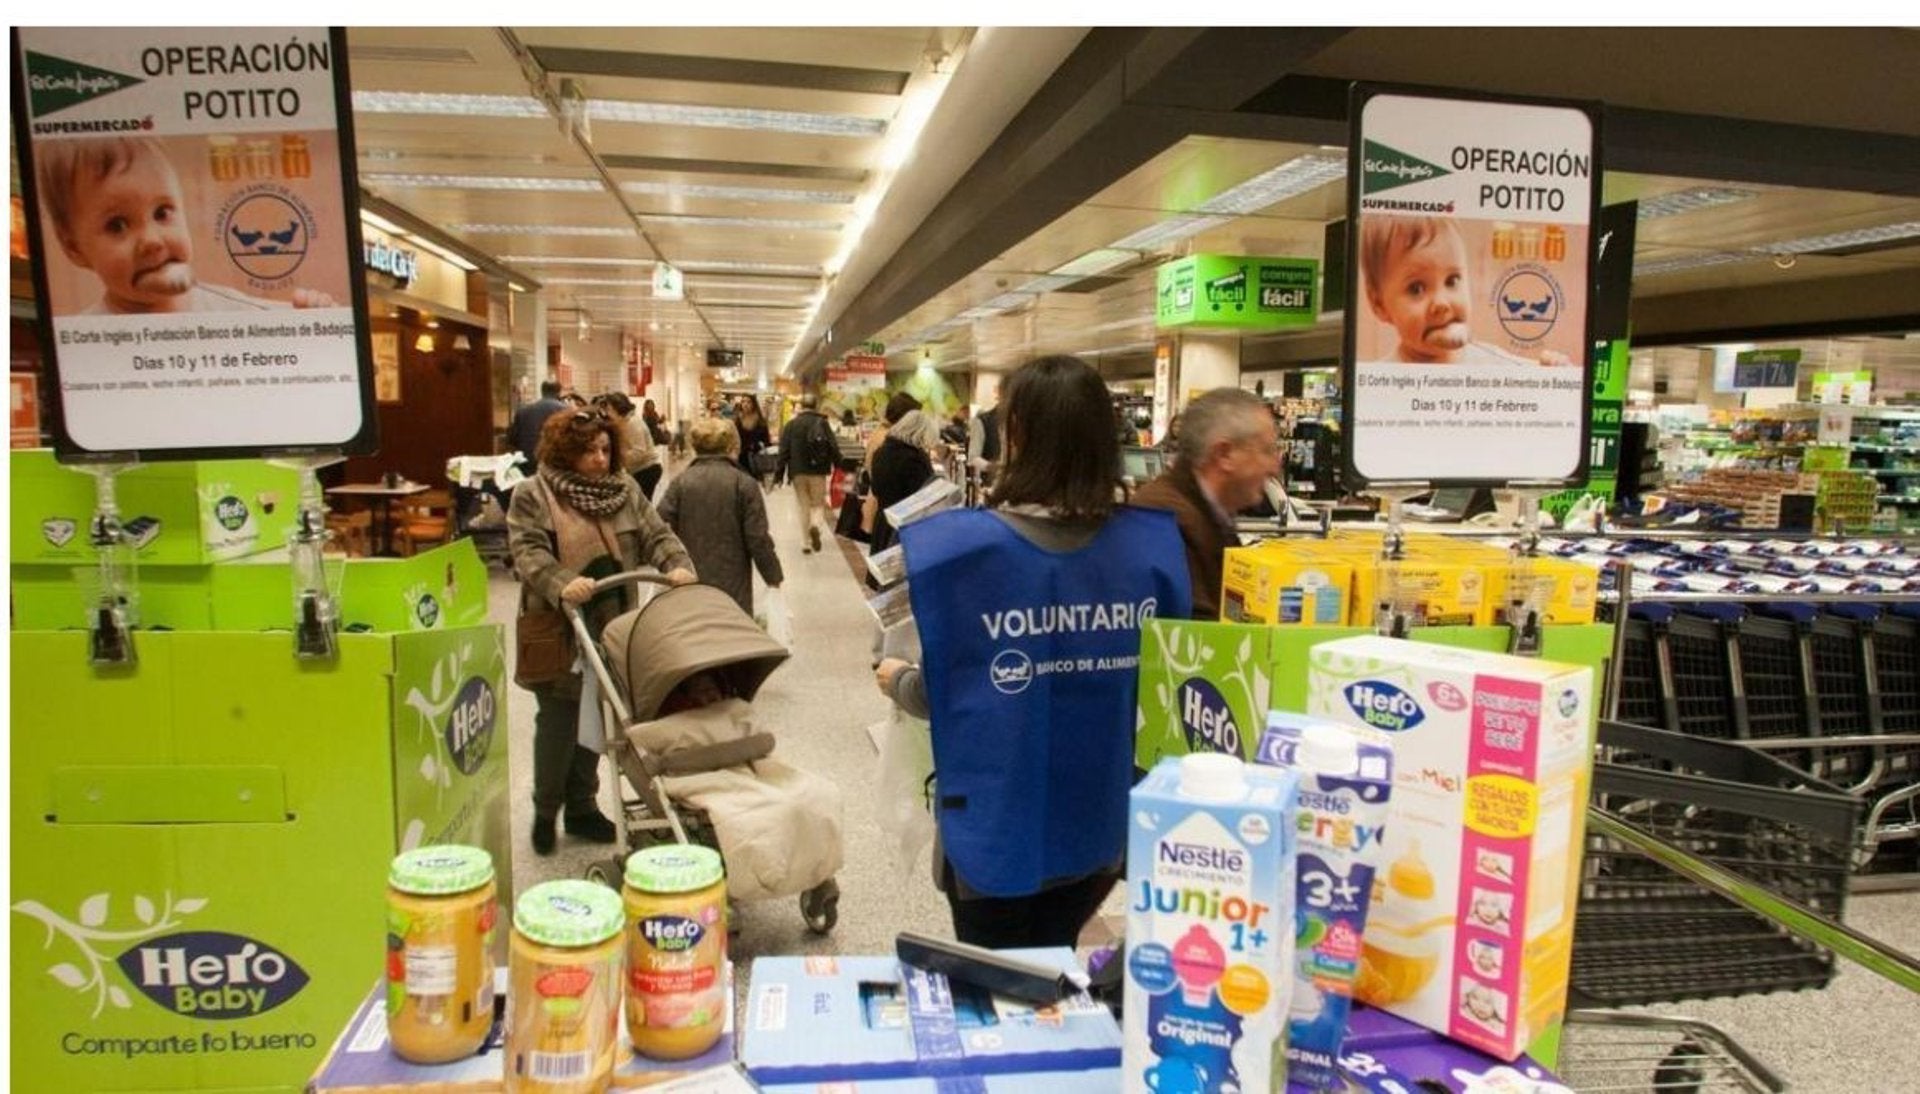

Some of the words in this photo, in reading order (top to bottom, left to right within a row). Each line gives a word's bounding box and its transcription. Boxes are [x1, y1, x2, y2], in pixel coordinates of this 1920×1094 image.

[141, 37, 329, 77] OPERACIÓN
[184, 87, 300, 120] POTITO
[1451, 146, 1588, 178] OPERACIÓN
[1480, 184, 1564, 212] POTITO
[60, 330, 70, 344] El
[72, 330, 100, 343] Corte
[143, 327, 196, 342] Fundación
[197, 325, 230, 340] Banco
[232, 325, 244, 339] de
[247, 322, 296, 338] Alimentos
[299, 322, 311, 337] de
[168, 354, 185, 369] 10
[188, 358, 197, 372] y
[202, 354, 216, 368] 11
[221, 355, 239, 367] de
[242, 351, 298, 366] Febrero
[1358, 374, 1367, 386] El
[1368, 375, 1390, 386] Corte
[1439, 400, 1453, 411] 10
[1455, 401, 1462, 414] y
[1465, 400, 1477, 411] 11
[1480, 400, 1493, 412] de
[1496, 399, 1538, 413] Febrero
[1036, 659, 1074, 675] BANCO
[1077, 659, 1094, 671] DE
[1352, 685, 1417, 716] Hero
[452, 683, 494, 753] Hero
[1184, 684, 1239, 755] Hero
[1365, 705, 1406, 729] Baby
[1160, 841, 1244, 872] Nestlé
[1133, 879, 1270, 928] Junior
[1302, 870, 1361, 908] 3+
[645, 919, 699, 939] Hero
[1230, 922, 1269, 952] 1+
[138, 943, 287, 987] Hero
[174, 984, 267, 1014] Baby
[61, 1032, 197, 1059] Comparte
[231, 1031, 317, 1052] bueno
[1157, 1020, 1232, 1049] Original
